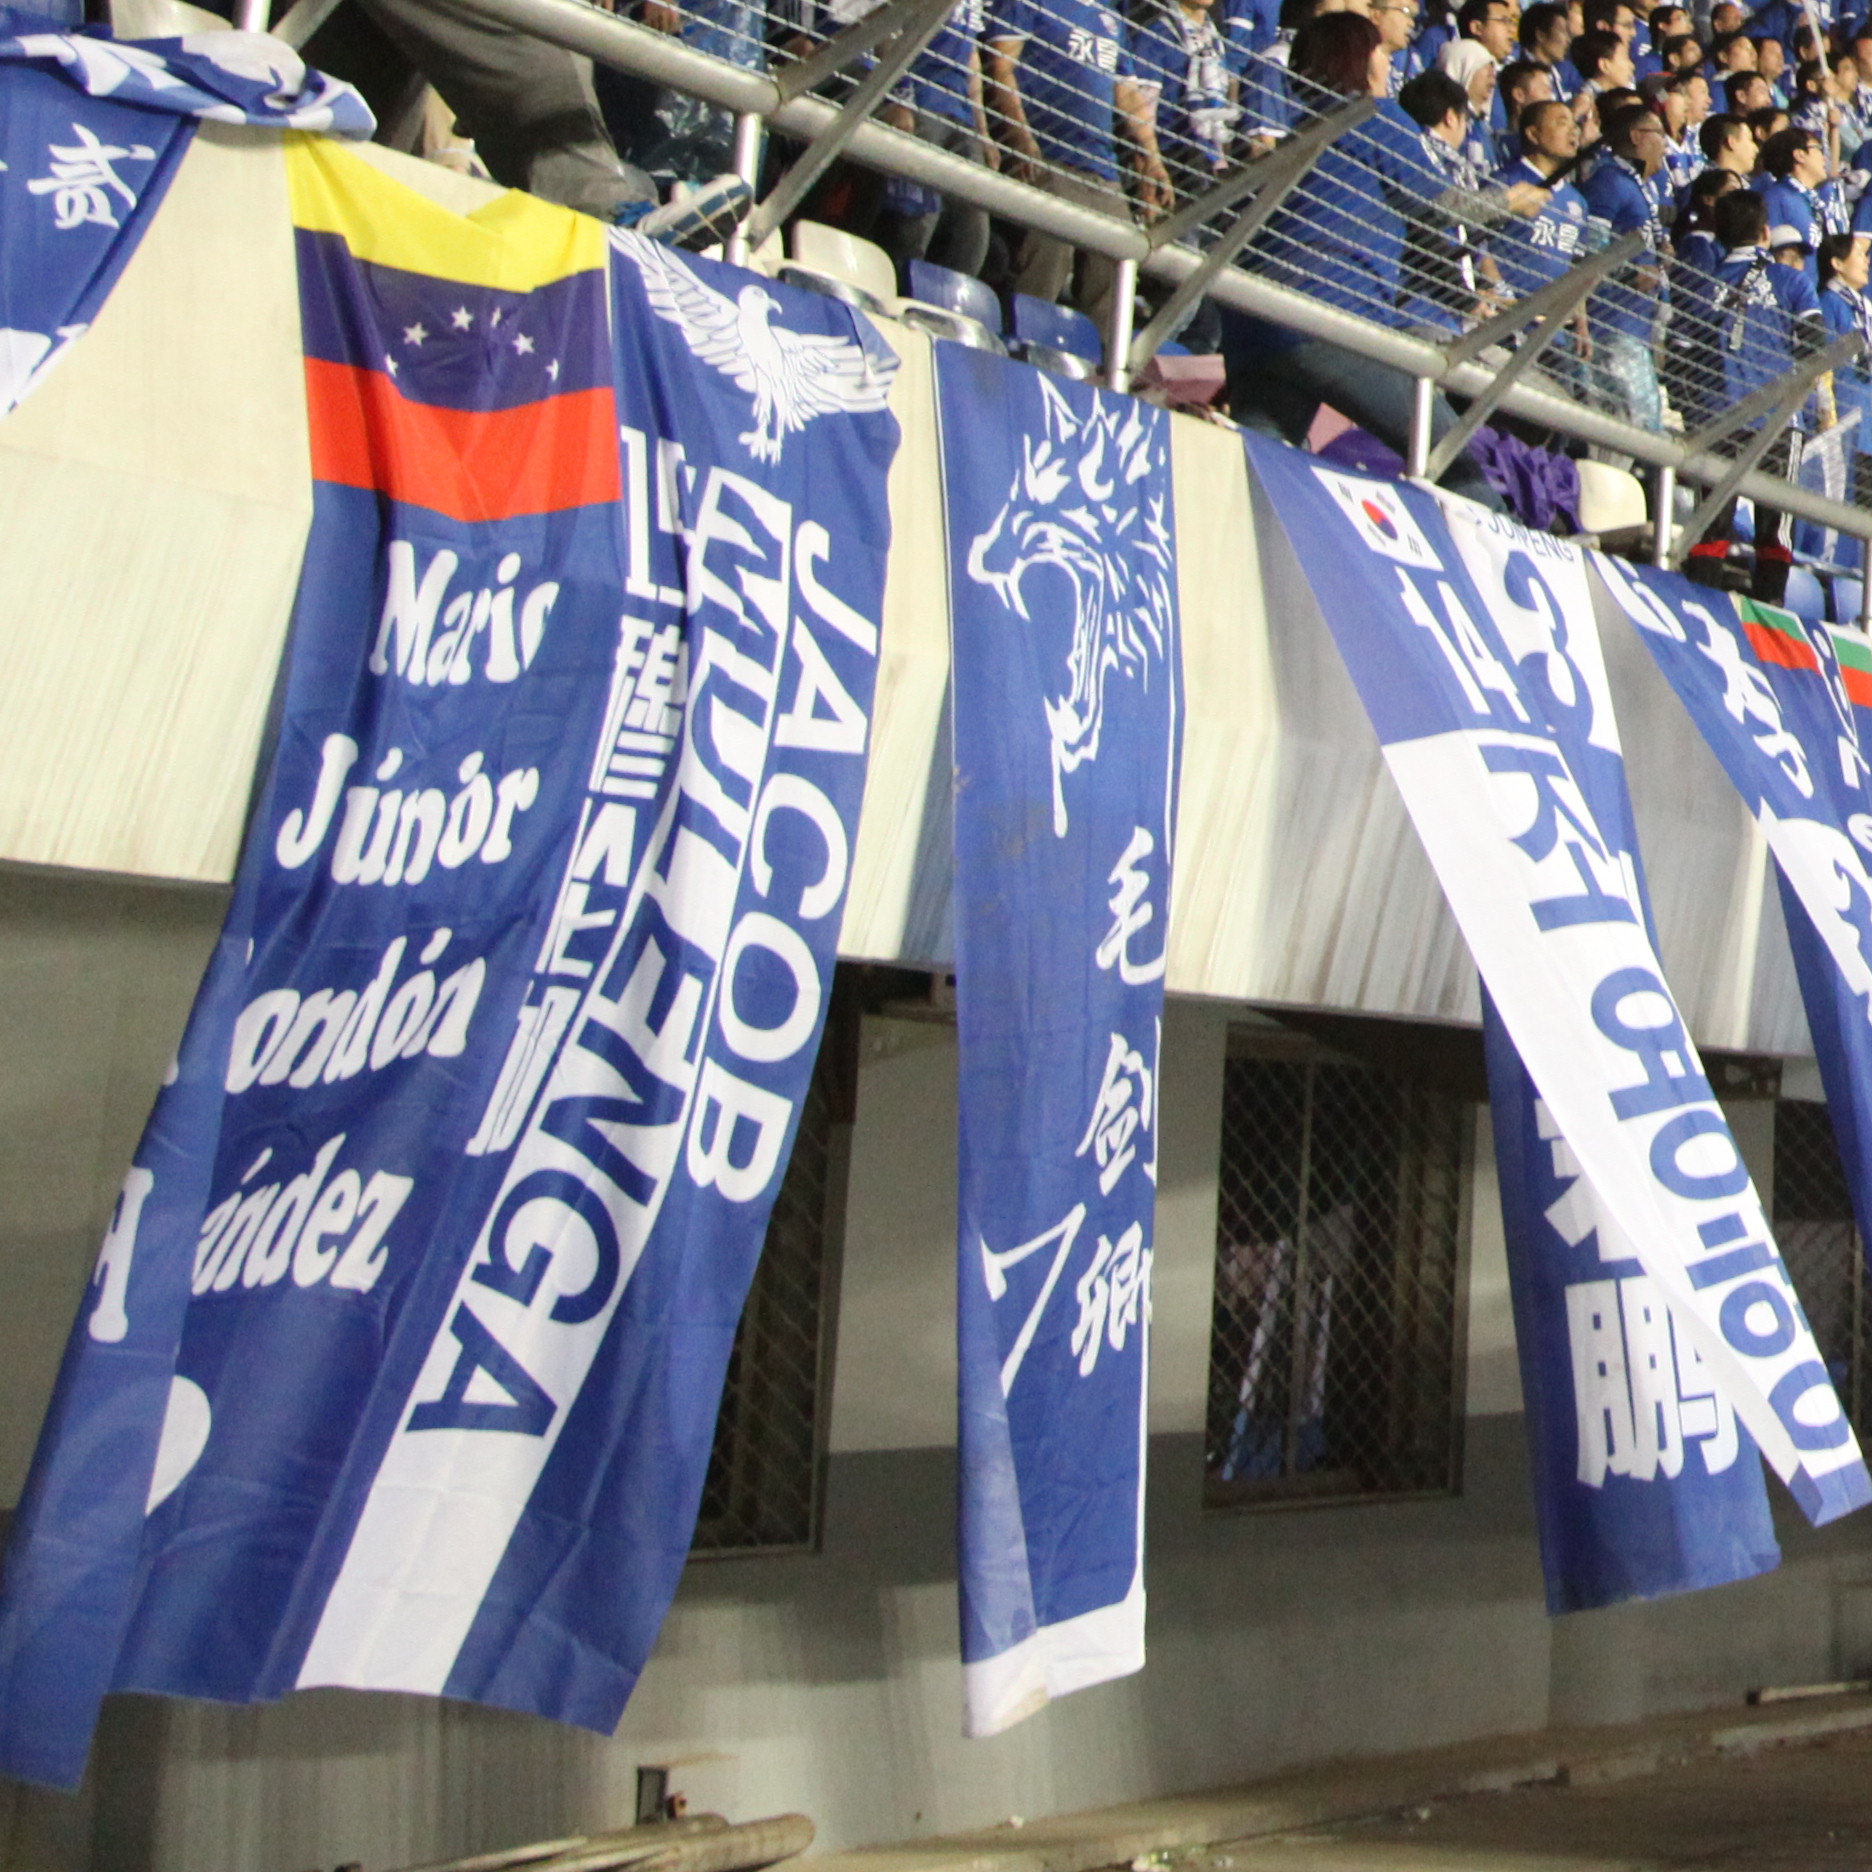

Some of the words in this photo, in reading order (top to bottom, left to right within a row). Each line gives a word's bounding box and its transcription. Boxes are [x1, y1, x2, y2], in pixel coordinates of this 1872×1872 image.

[1068, 27, 1119, 74] 永昌
[1530, 215, 1580, 255] 永昌
[1394, 566, 1532, 724] 14
[687, 519, 880, 1204] JACOB
